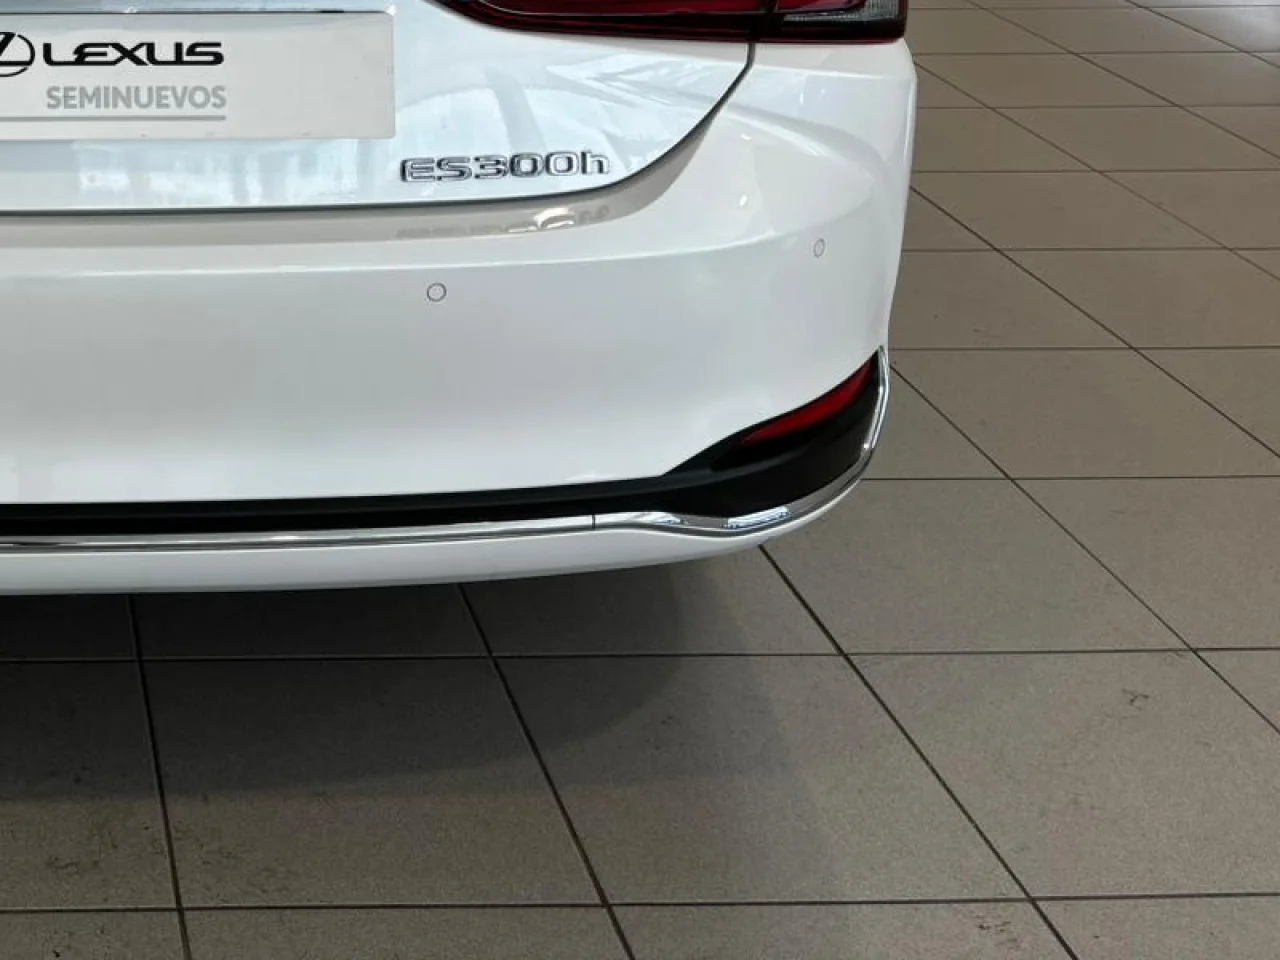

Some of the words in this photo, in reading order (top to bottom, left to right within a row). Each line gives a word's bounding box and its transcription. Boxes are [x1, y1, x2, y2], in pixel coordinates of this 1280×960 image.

[43, 41, 224, 66] LEXUS
[46, 85, 226, 109] SEMINUEVOS
[400, 149, 611, 182] ES300h
